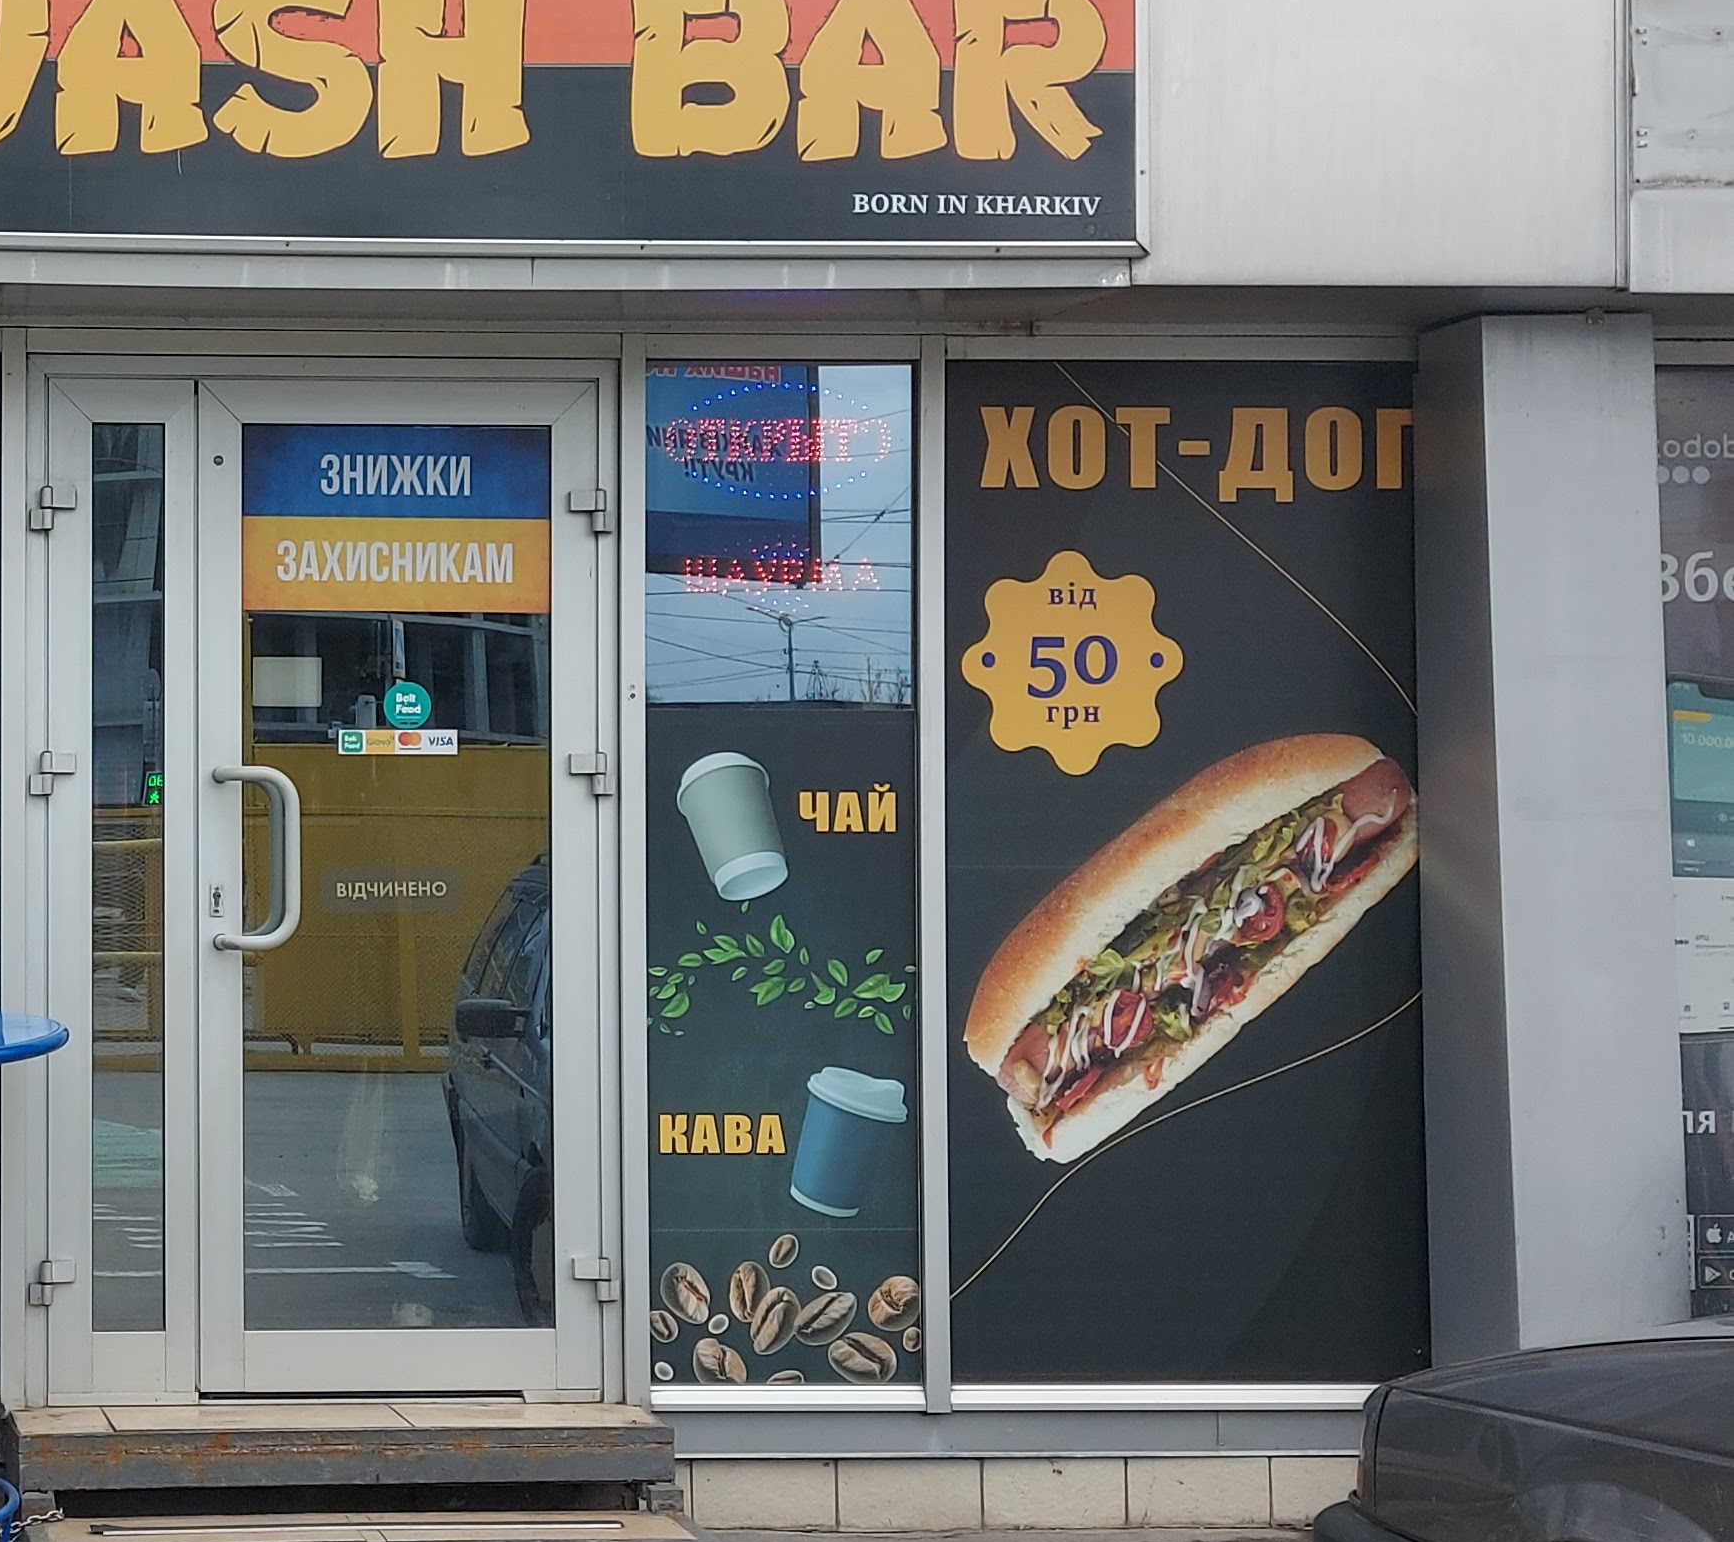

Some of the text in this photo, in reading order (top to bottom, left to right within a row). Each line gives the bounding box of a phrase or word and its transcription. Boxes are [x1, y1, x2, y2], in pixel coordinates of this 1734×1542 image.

[852, 193, 1102, 216] BORN IN KHARKIV
[980, 405, 1414, 503] ХОТ-ДОГ
[320, 453, 471, 497] ЗНИЖКИ
[276, 540, 514, 584] ЗАХИСНИКАМ
[1047, 581, 1097, 611] від
[1027, 634, 1118, 699] 50
[1046, 705, 1101, 730] грн
[428, 736, 454, 747] VISA
[799, 782, 897, 832] ЧАЙ
[336, 880, 447, 901] ВІДЧИНЕНО
[659, 1113, 787, 1154] КАВА
